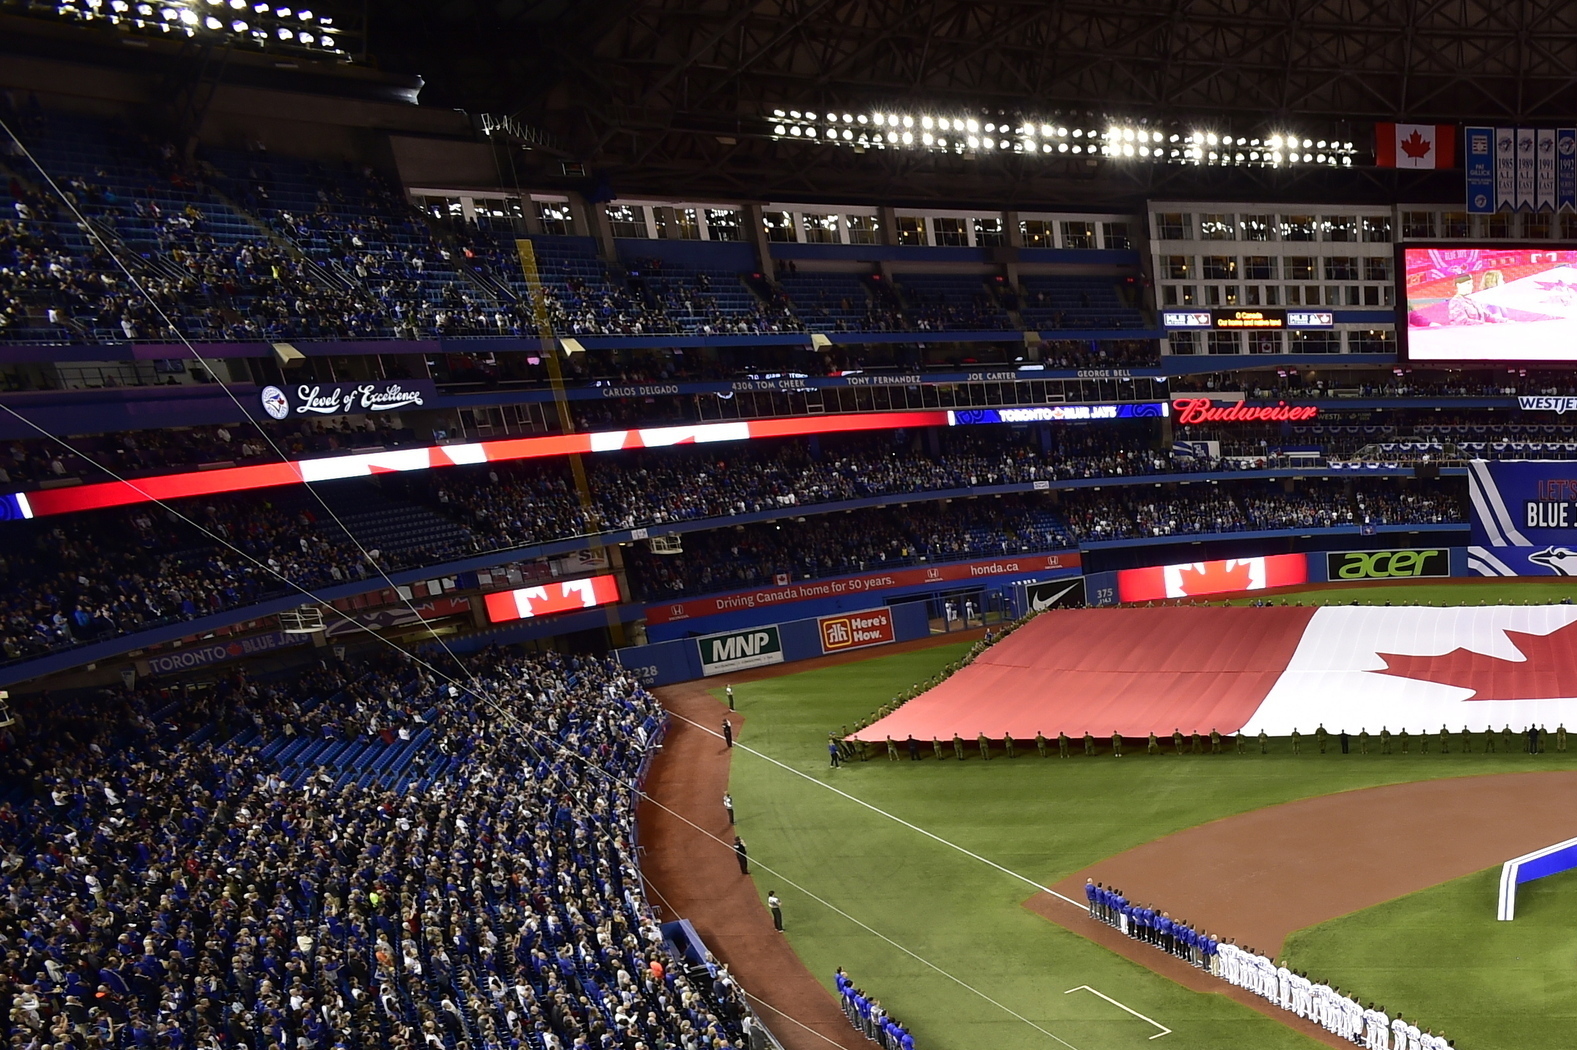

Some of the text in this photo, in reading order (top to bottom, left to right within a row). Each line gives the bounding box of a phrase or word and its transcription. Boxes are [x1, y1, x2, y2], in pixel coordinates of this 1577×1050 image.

[1498, 158, 1513, 170] 1985
[1519, 158, 1534, 170] 1989
[1540, 158, 1554, 170] 1991
[1560, 159, 1574, 170] 1992
[1499, 181, 1513, 189] EAST
[1519, 181, 1534, 189] EAST
[1540, 181, 1554, 189] EAST
[967, 371, 1017, 382] JOE CARTER
[1077, 369, 1132, 378] GEORGE BELL
[731, 381, 753, 391] 4306
[756, 380, 775, 390] TOM
[778, 379, 806, 389] CHEEK
[846, 374, 921, 386] TONY FERNANDEZ
[602, 384, 679, 398] CARLOS DELGADO
[296, 384, 341, 414] Level
[343, 390, 358, 413] of
[357, 383, 424, 411] Excellence
[998, 405, 1118, 422] TORONTO BLUE JAYS
[1172, 397, 1318, 424] Budweiser
[1527, 502, 1569, 527] BLUE
[970, 562, 1019, 576] honda.ca
[1338, 550, 1439, 579] acer
[716, 575, 896, 610] Driving Canada home for 50 years.
[1097, 588, 1114, 599] 375
[668, 613, 690, 621] HONDA
[851, 616, 887, 629] Here's
[853, 630, 883, 642] How.
[149, 630, 310, 674] TORONTO BLUE JAYS
[712, 632, 770, 662] MNP
